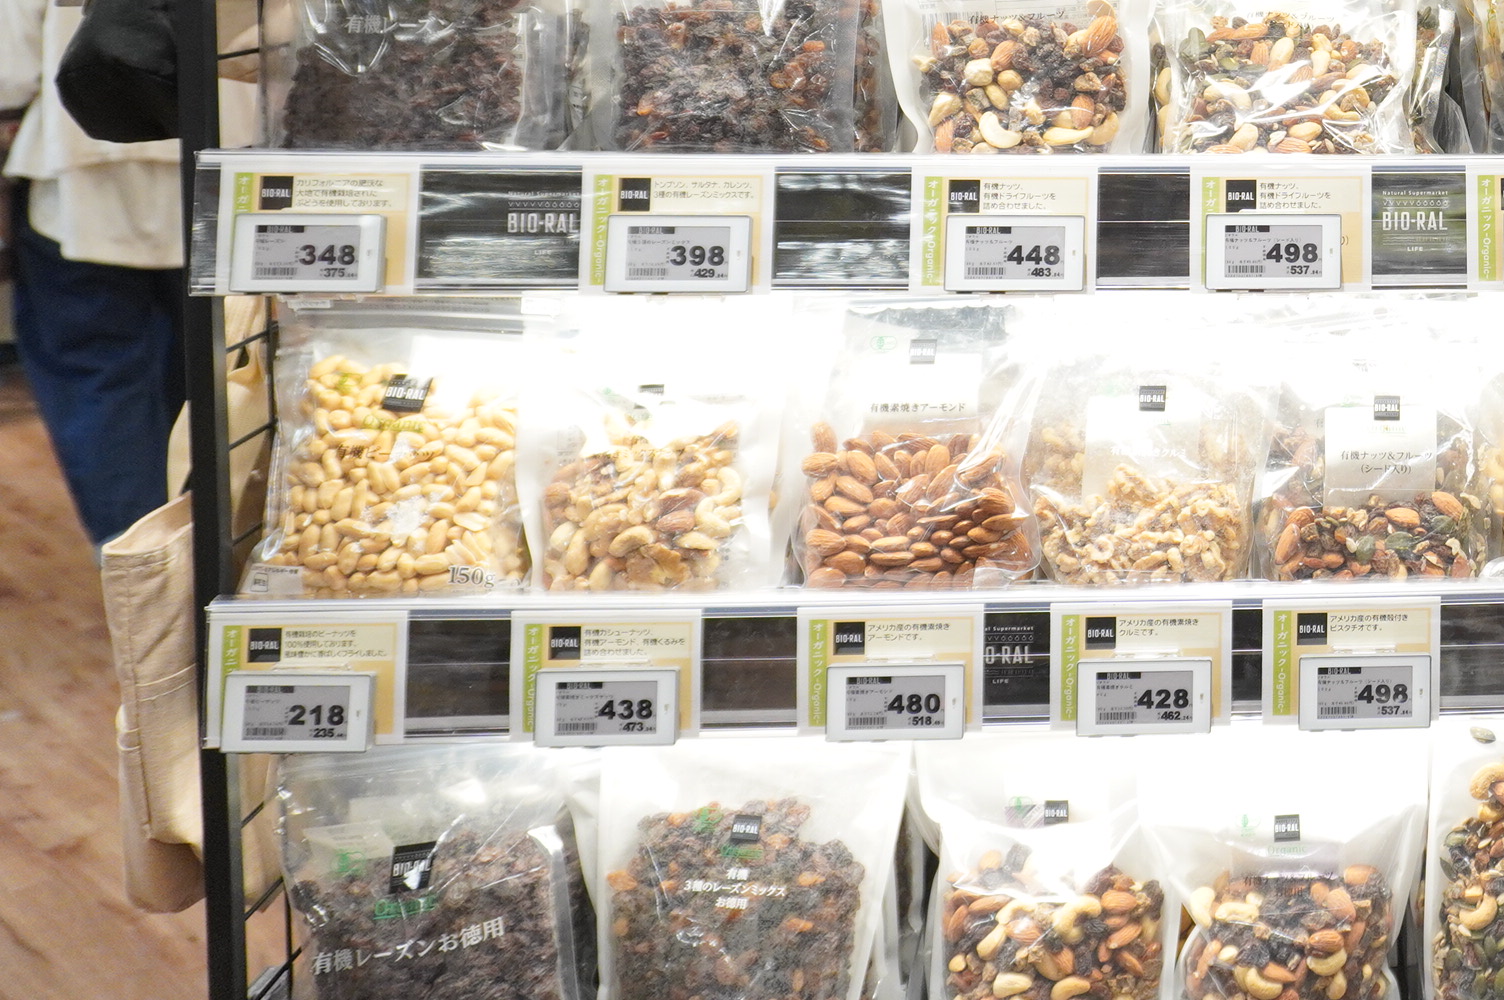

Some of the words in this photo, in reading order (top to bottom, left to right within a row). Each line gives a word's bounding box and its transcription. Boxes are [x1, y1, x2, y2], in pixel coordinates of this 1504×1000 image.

[261, 188, 291, 198] BIO-RAL
[620, 190, 648, 200] BIO-RAL
[950, 192, 978, 201] BIO-RAL
[1227, 191, 1255, 201] BIO-RAL
[1408, 189, 1449, 197] Supermarket
[507, 212, 579, 234] BIO-RAL
[1382, 210, 1448, 231] BIO-RAL
[299, 244, 356, 266] 348
[669, 245, 725, 266] 398
[1006, 244, 1061, 265] 448
[1265, 242, 1319, 264] 498
[385, 386, 425, 400] BIO-RAL
[1140, 394, 1165, 403] BIO-RAL
[870, 402, 966, 413] 有機素焼きアーモンド
[1374, 403, 1400, 412] BIO-RAL
[448, 565, 496, 589] 150g
[992, 625, 1034, 633] Supermarket
[1087, 629, 1115, 638] BIO-RAL
[1299, 624, 1325, 634] BIO-RAL
[250, 640, 279, 650] BIO-RAL
[550, 638, 579, 648] BIO-RAL
[835, 633, 863, 644] BIO-RAL
[985, 644, 1034, 665] O-RAL
[1136, 688, 1189, 709] 428
[1357, 683, 1409, 704] 498
[598, 699, 654, 721] 438
[887, 693, 942, 715] 480
[287, 704, 345, 726] 218
[1044, 809, 1068, 818] BIO-RAL
[732, 823, 759, 835] BIO-RAL
[1274, 823, 1300, 833] BIO-RAL
[726, 867, 750, 881] 有機
[683, 879, 786, 897] 3種のレーズンミックス
[715, 897, 748, 910] お徳用
[310, 916, 505, 976] 有機レーズンお徳用
